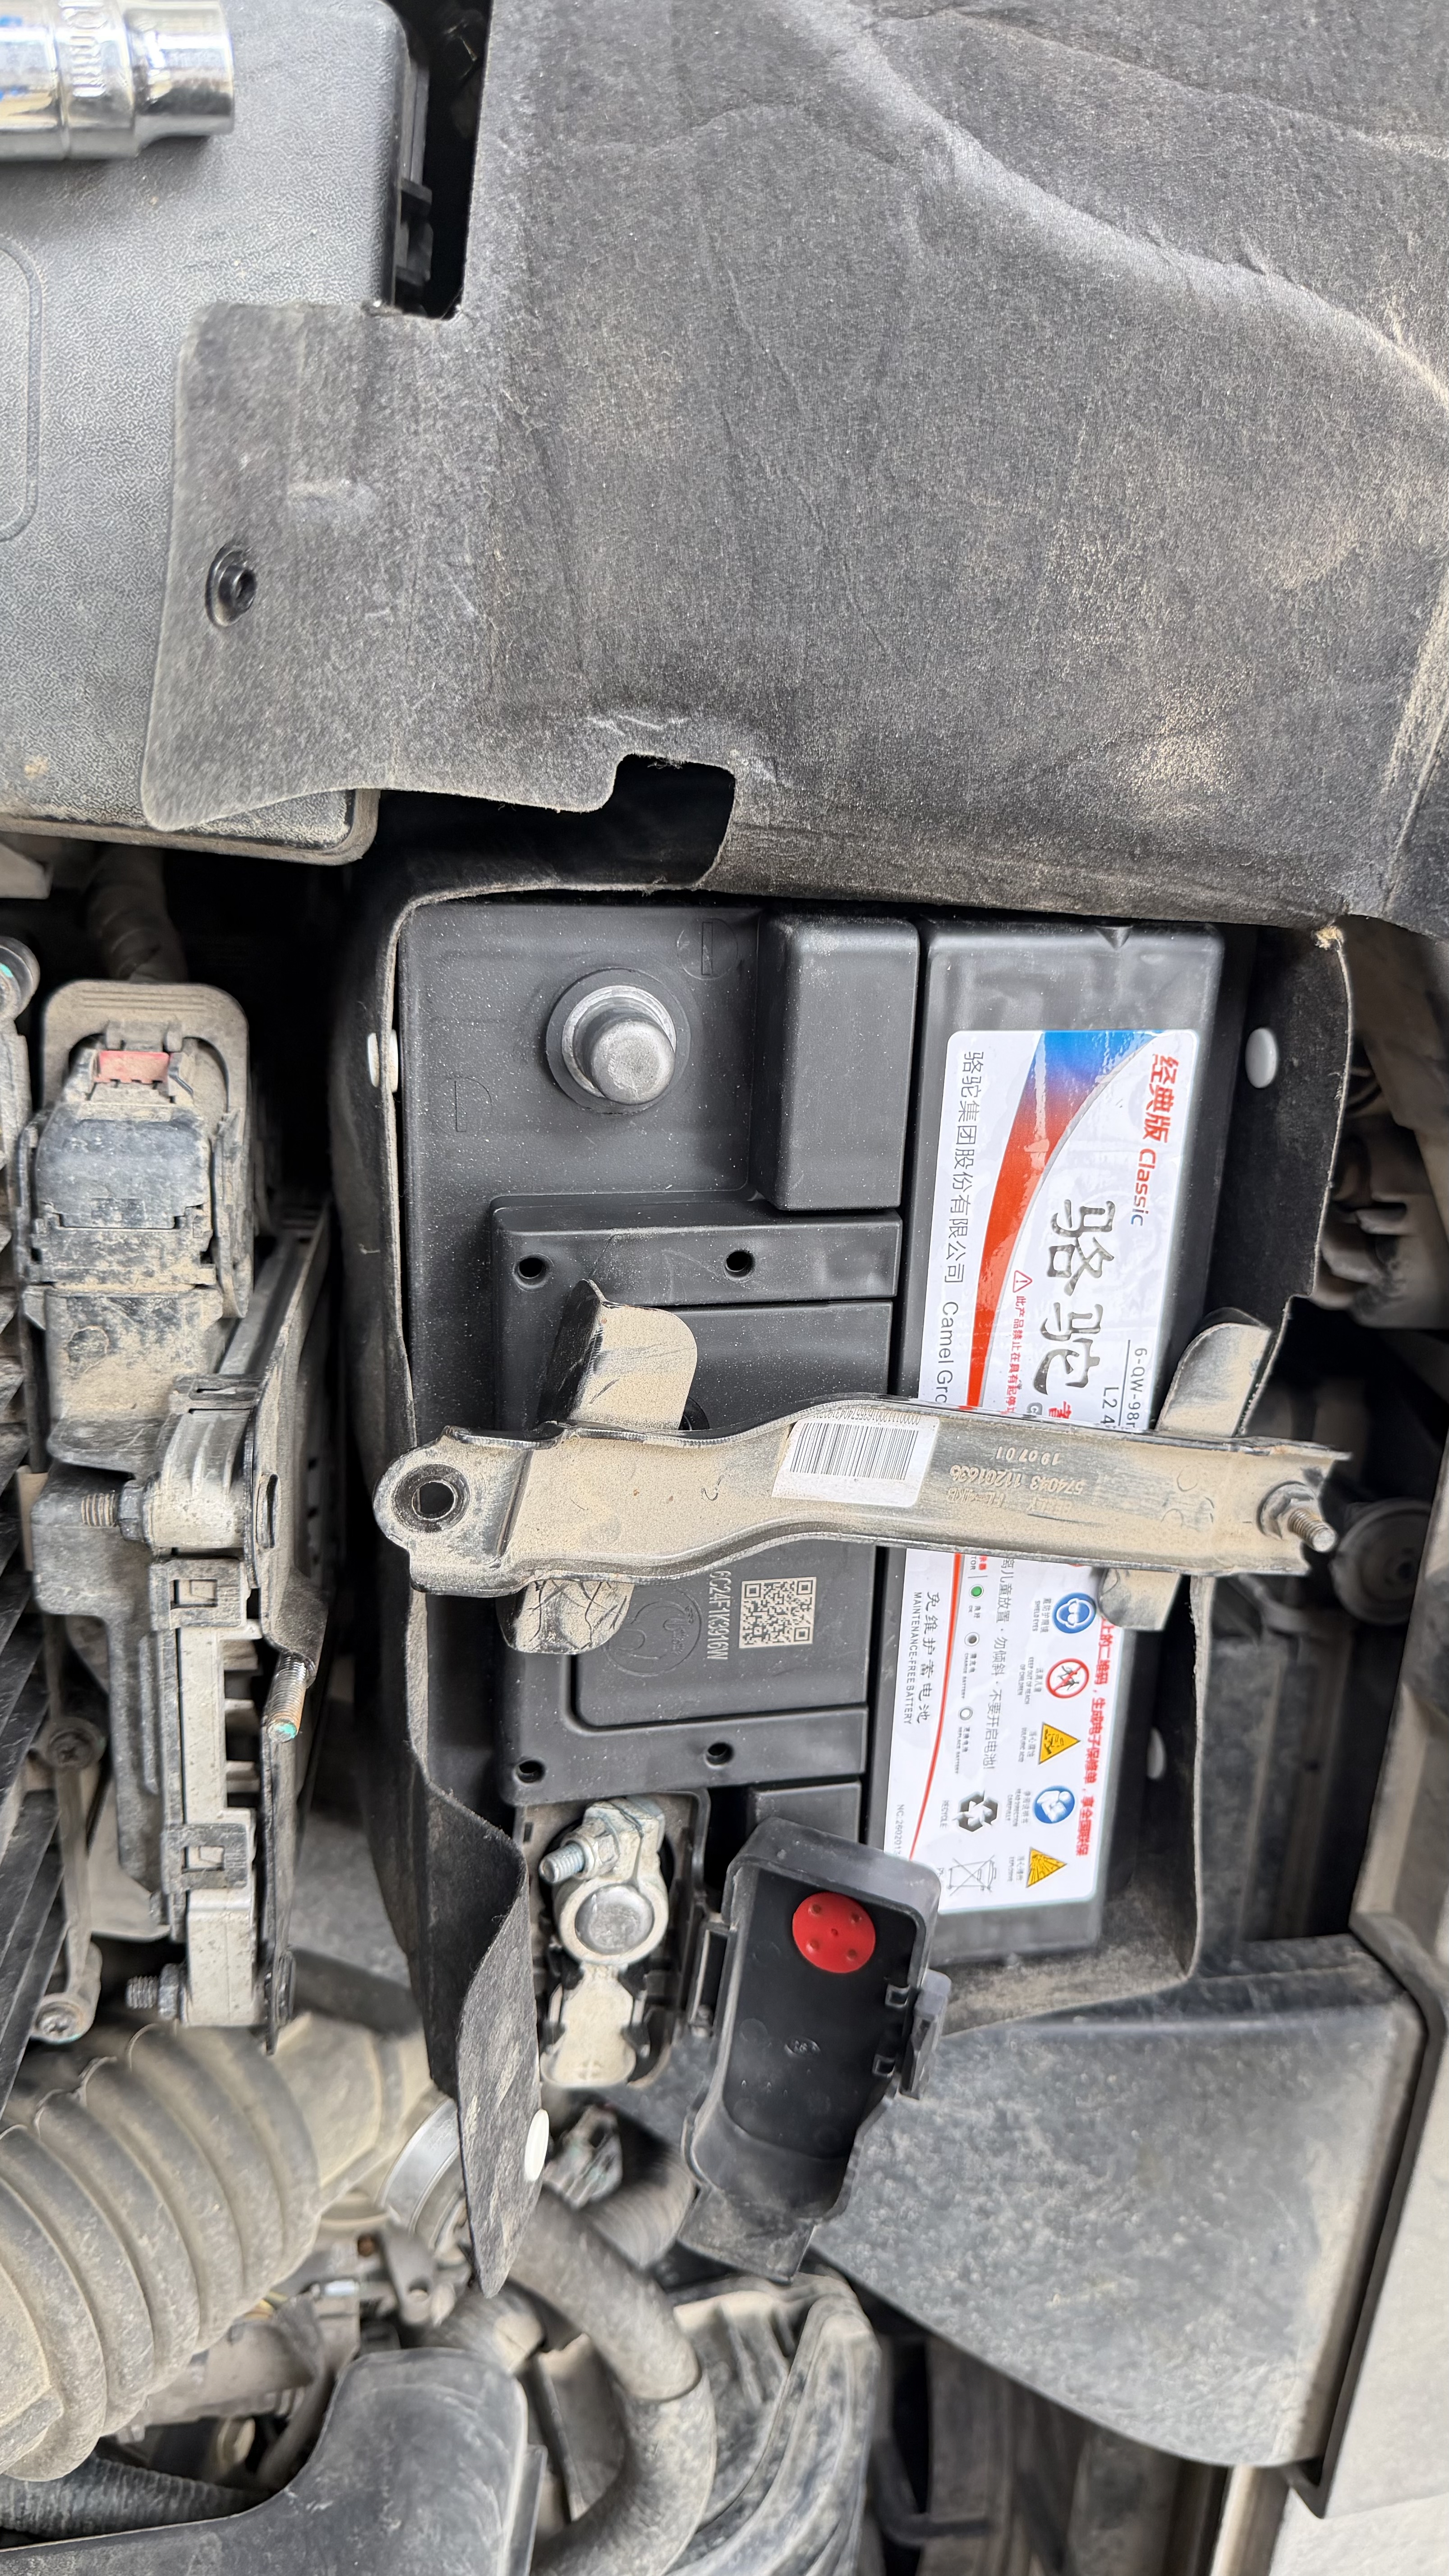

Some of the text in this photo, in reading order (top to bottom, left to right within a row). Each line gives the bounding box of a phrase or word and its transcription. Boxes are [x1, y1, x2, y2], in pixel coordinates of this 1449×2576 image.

[944, 1051, 984, 1283] 骆驼集团股份有限公司
[1131, 1054, 1179, 1226] 经典版 Classic
[938, 1302, 959, 1363] Camel
[1033, 1200, 1116, 1395] 骆驼
[707, 1570, 731, 1660] 6C24F1K3916W
[904, 1592, 922, 1725] MAINTENANCE-FREE BATTERY
[917, 1592, 940, 1724] 免维护蓄电池
